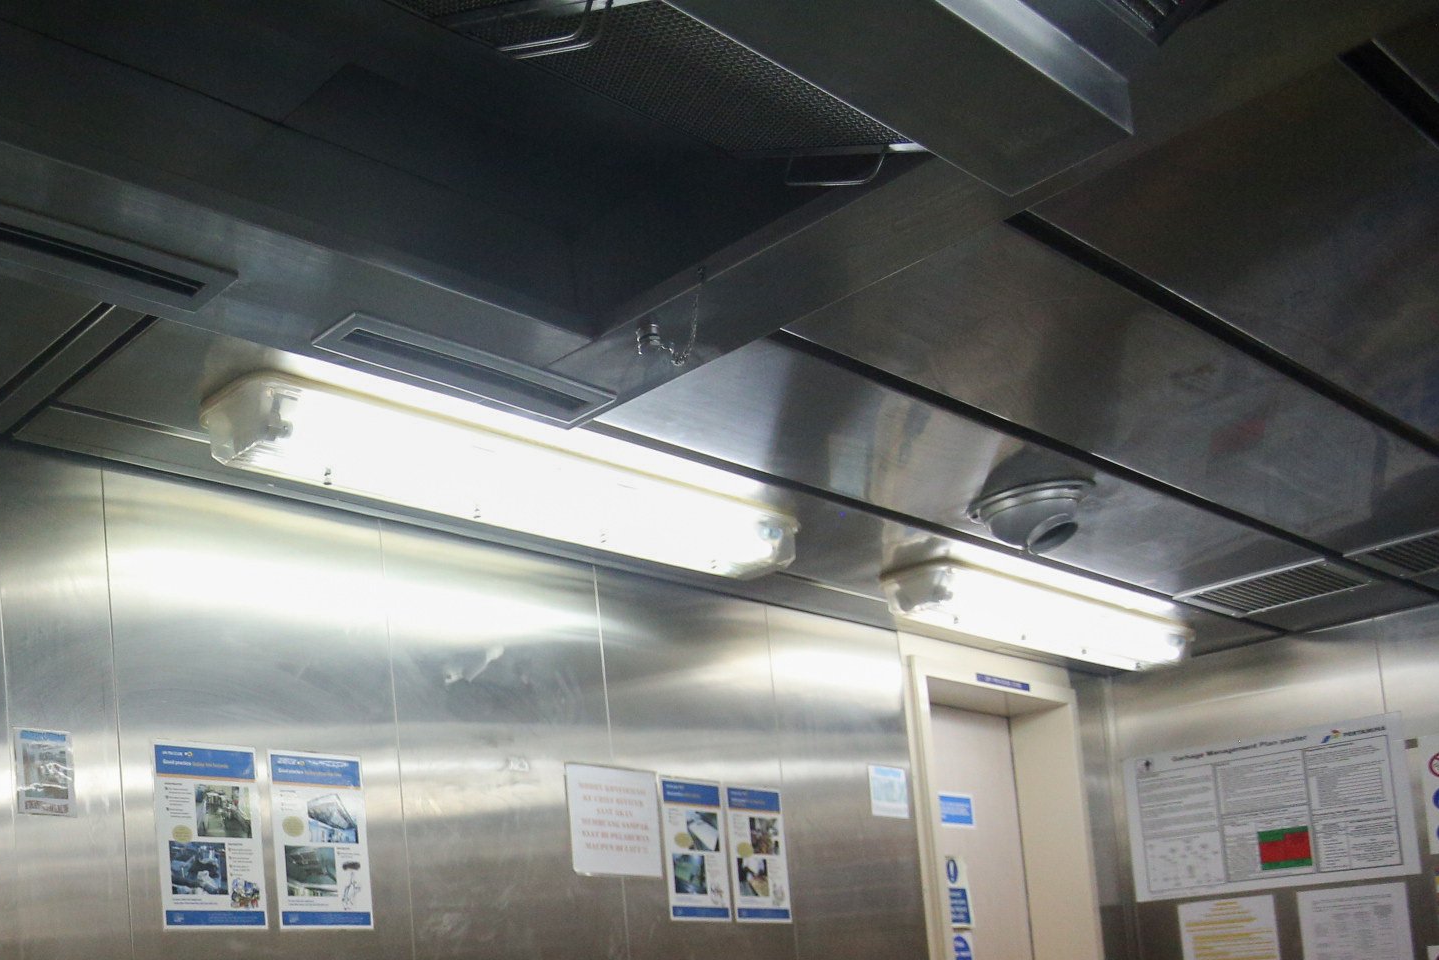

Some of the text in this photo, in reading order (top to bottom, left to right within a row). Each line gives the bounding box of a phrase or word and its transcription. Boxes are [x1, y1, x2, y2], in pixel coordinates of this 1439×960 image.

[1343, 725, 1387, 737] PERTAMINA
[1170, 751, 1204, 762] Garbage
[1206, 743, 1258, 757] Management
[1259, 739, 1279, 748] Plan
